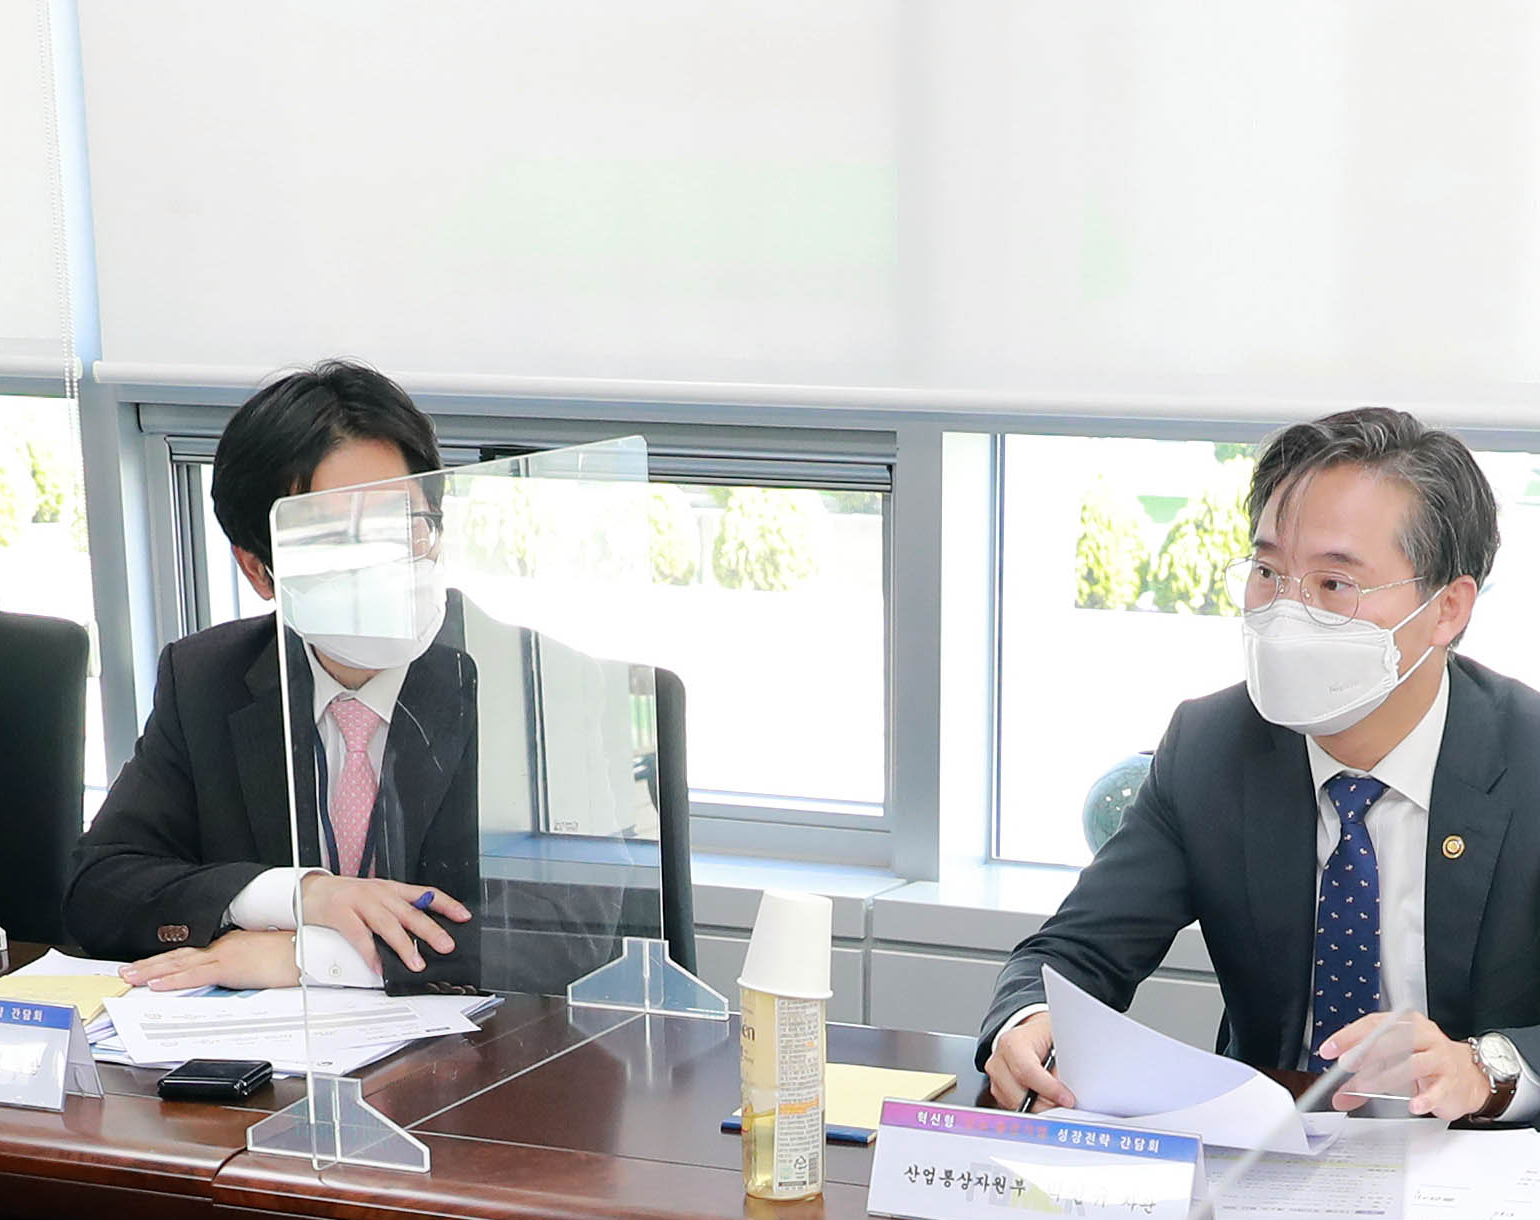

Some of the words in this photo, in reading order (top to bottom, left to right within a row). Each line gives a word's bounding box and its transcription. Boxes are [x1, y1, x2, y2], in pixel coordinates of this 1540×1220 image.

[11, 1007, 44, 1023] 간담회
[916, 1110, 956, 1129] 혁신형
[1056, 1127, 1111, 1148] 성장전략
[1119, 1135, 1160, 1154] 간담회
[903, 1163, 1027, 1198] 산업통상자원부
